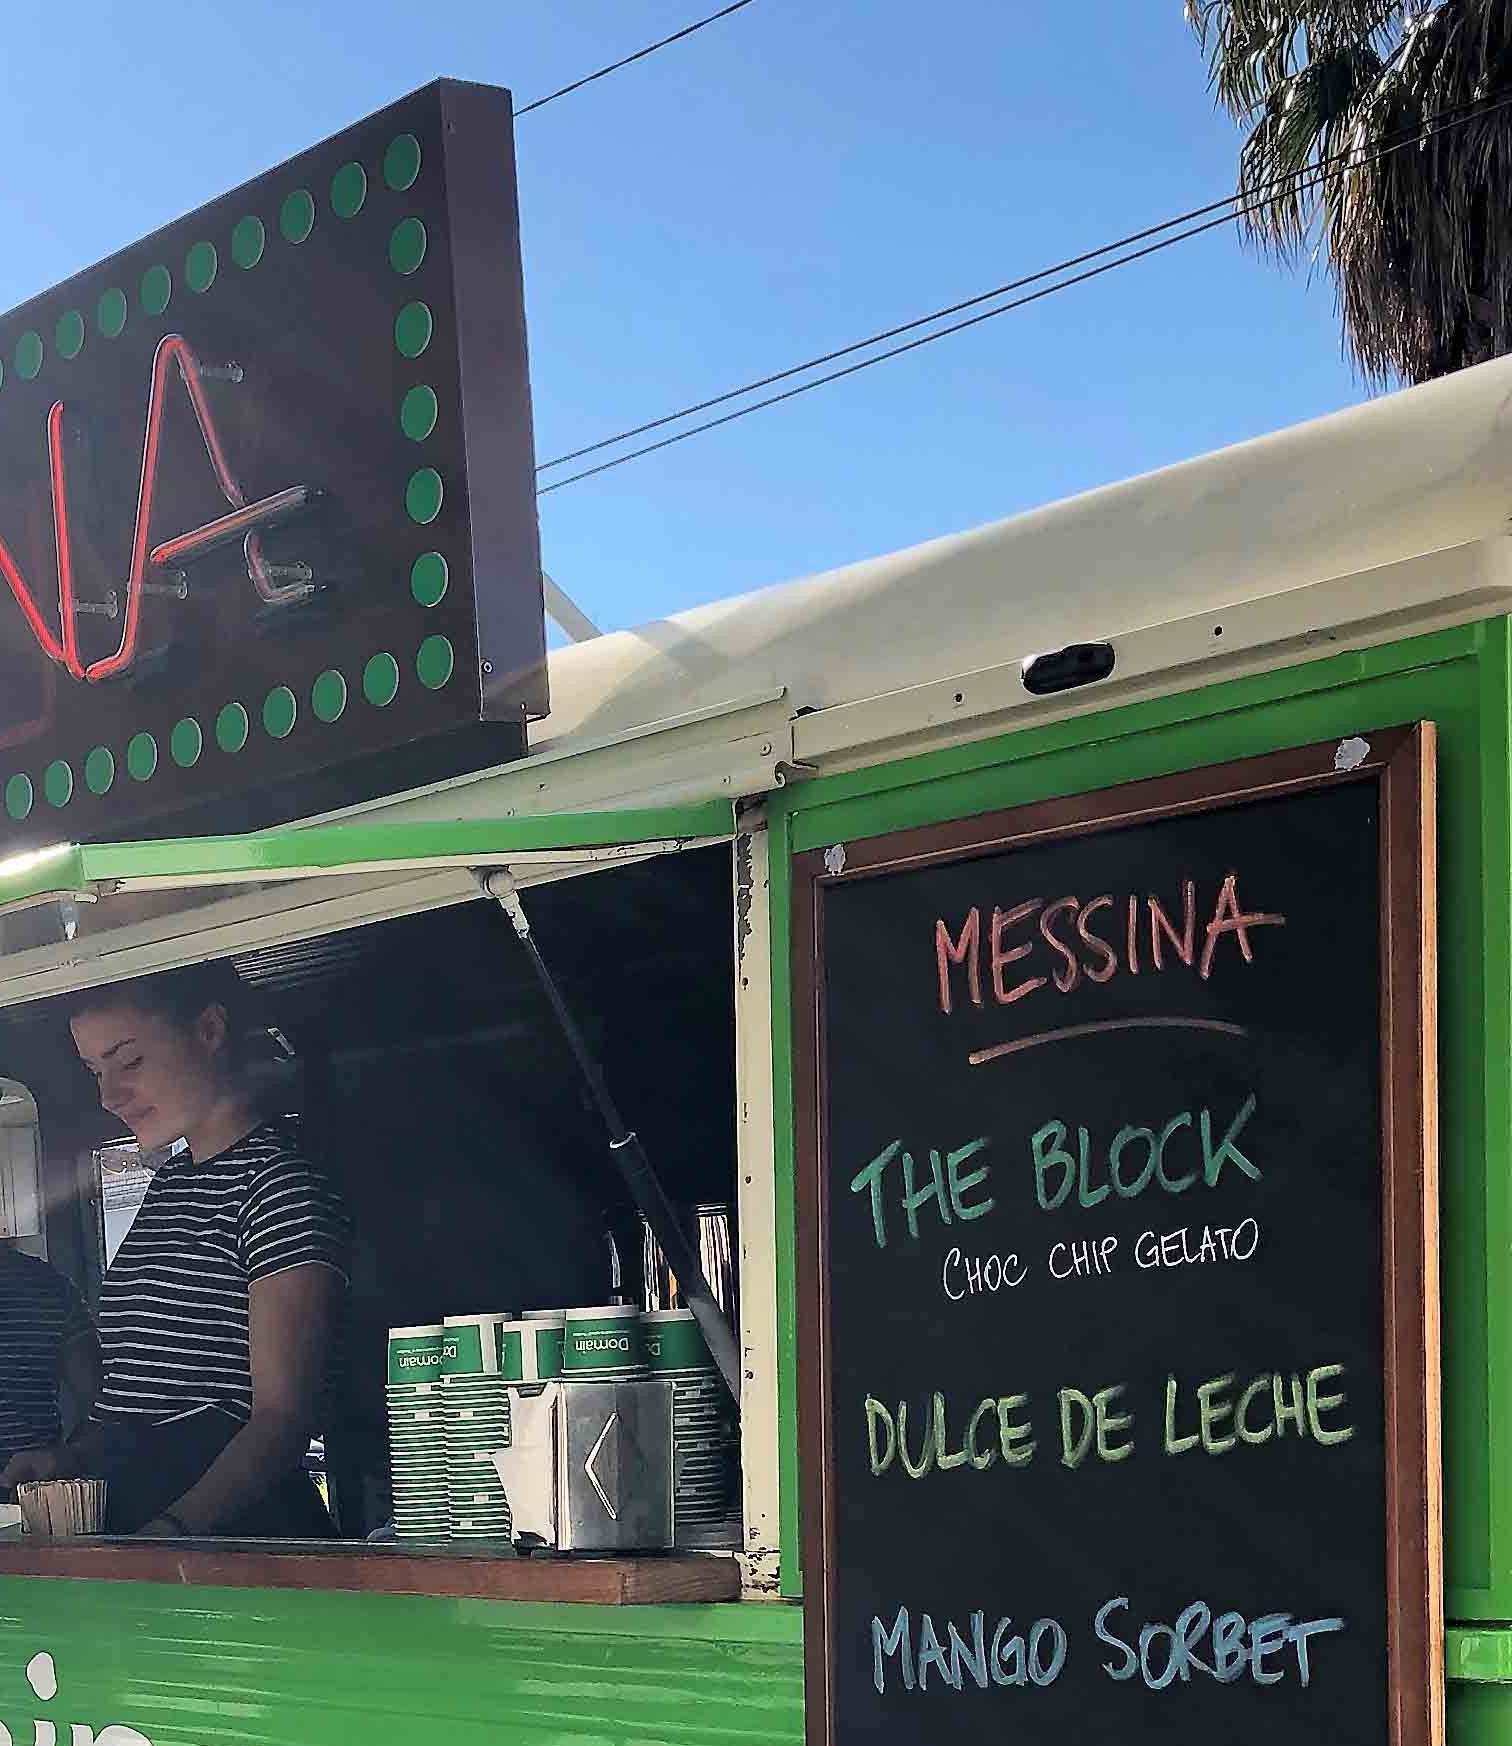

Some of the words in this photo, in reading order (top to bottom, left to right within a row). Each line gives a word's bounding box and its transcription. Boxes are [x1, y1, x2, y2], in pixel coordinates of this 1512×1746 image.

[935, 873, 1285, 1014] MESSINA
[850, 1138, 994, 1249] THE
[1031, 1094, 1264, 1209] BLOCK
[942, 1246, 1027, 1301] CHOC
[1048, 1235, 1118, 1280] CHIP
[1134, 1217, 1259, 1269] GELATO
[575, 1337, 629, 1355] Domain
[864, 1390, 1039, 1479] DULCE
[1059, 1383, 1136, 1468] DE
[1162, 1362, 1355, 1457] LECHE
[870, 1604, 1068, 1694] MANGO
[1095, 1595, 1345, 1690] SORBET
